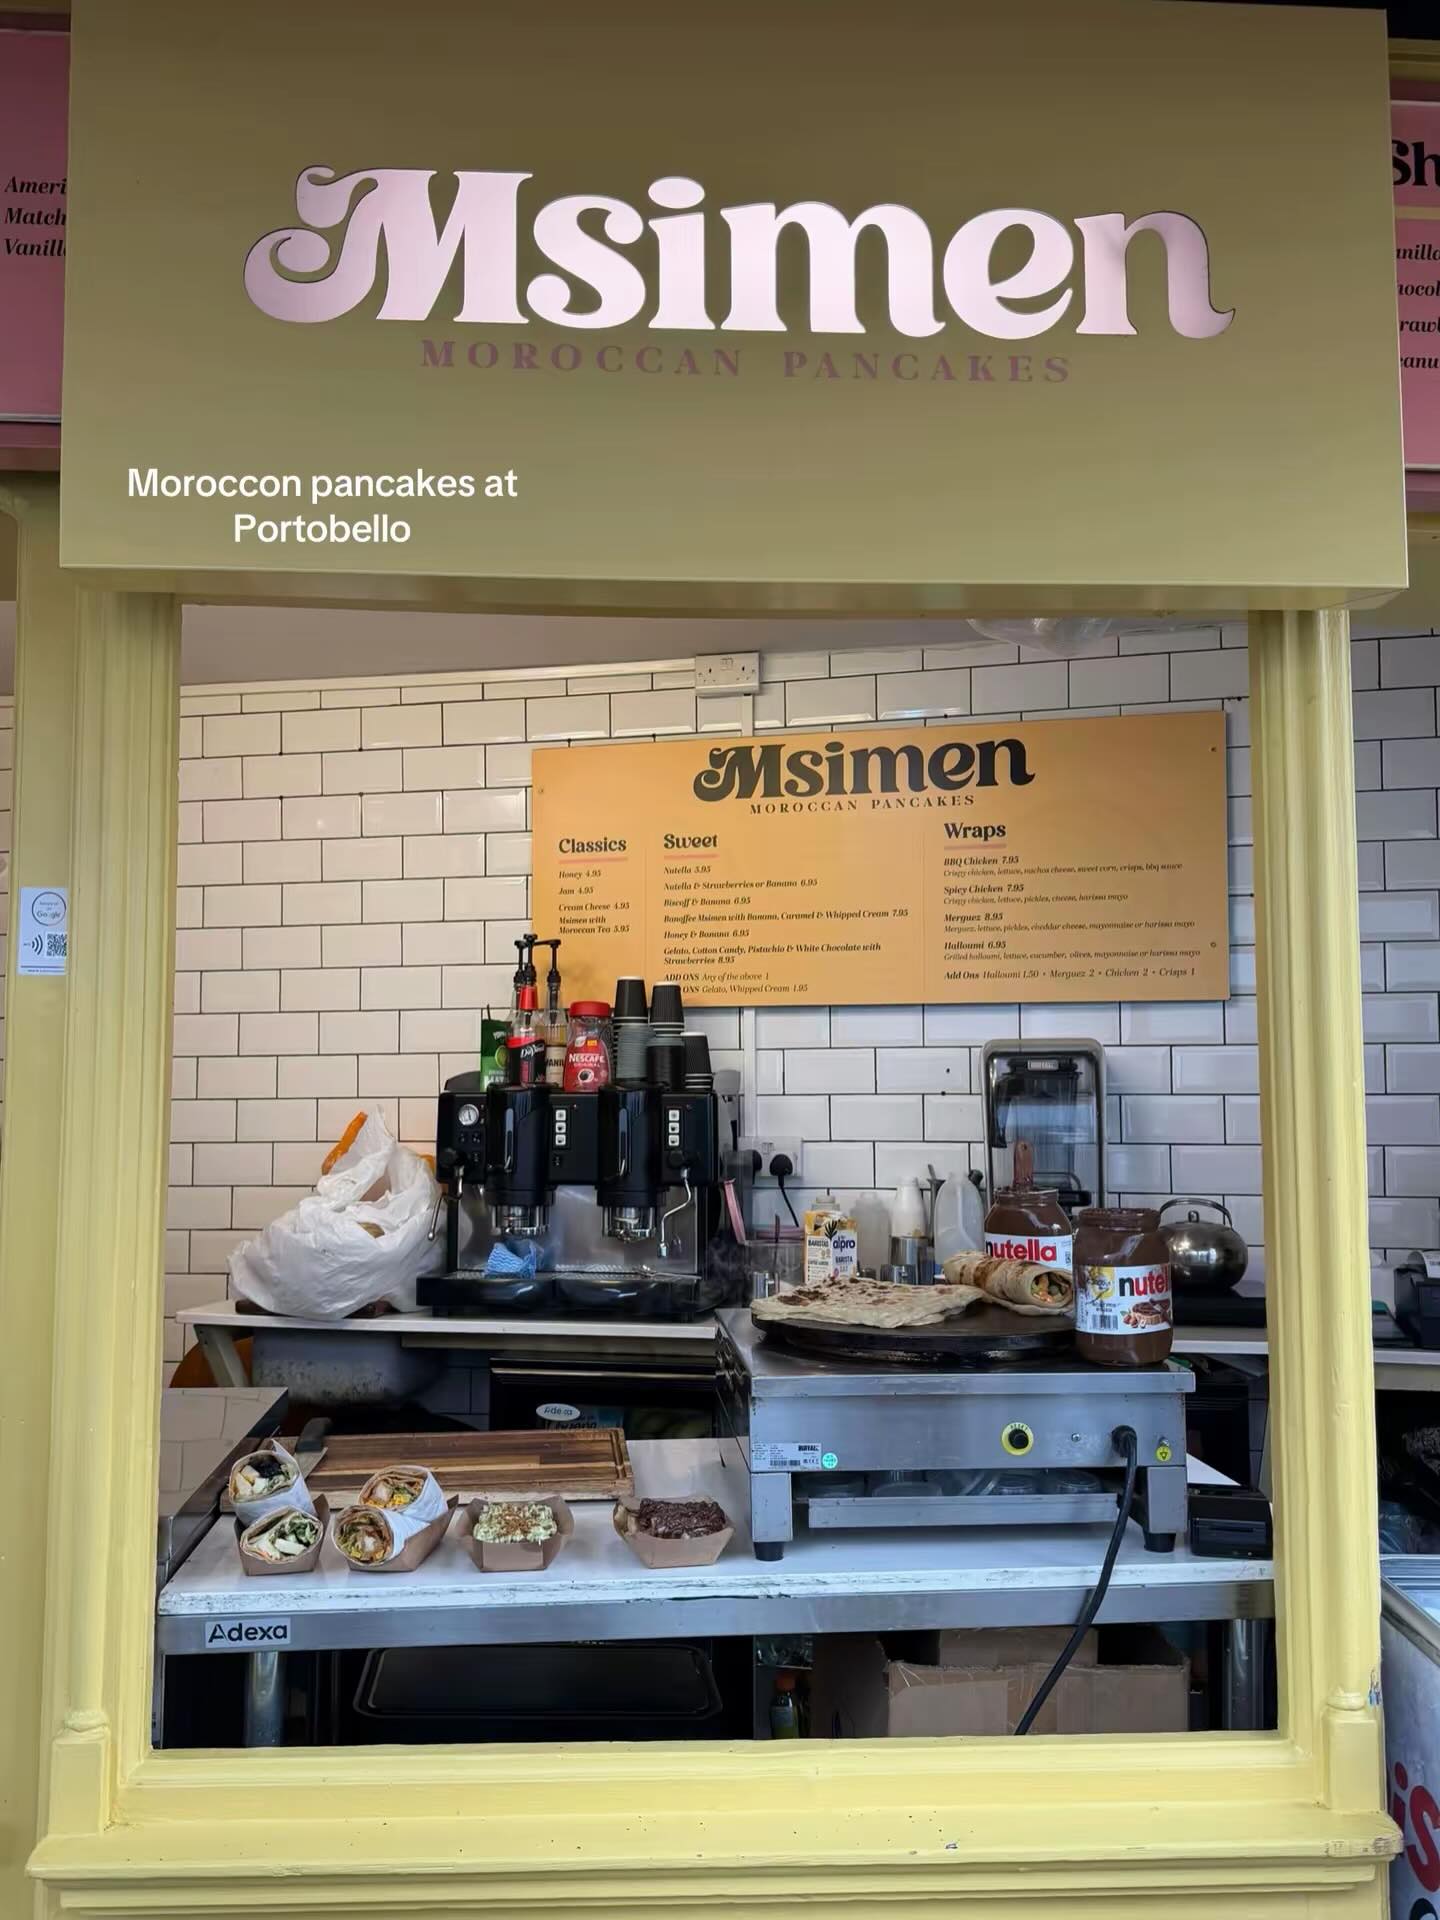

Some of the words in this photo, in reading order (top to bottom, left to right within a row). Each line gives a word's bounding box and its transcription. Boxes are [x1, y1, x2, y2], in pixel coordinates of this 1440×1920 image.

[4, 238, 66, 257] Vanill
[244, 165, 1235, 339] Msimen
[421, 339, 741, 378] MOROCCAN
[783, 350, 1071, 383] PANCAKES
[693, 738, 1036, 802] Msimen
[750, 799, 858, 815] MOROCCAN
[871, 795, 975, 809] PANCAKES
[943, 822, 1007, 842] Wraps
[558, 837, 627, 854] Classics
[663, 833, 718, 849] Sweet
[943, 858, 963, 868] BBQ
[963, 856, 999, 867] Chicken
[1001, 855, 1020, 865] 7.95
[558, 870, 583, 881] Honey
[663, 865, 692, 875] Nutella
[663, 881, 692, 891] Nutella
[702, 879, 755, 890] Strawberries
[755, 880, 766, 888] or
[766, 878, 798, 888] Banana
[800, 877, 818, 887] 6.95
[943, 886, 968, 896] Spicy
[968, 884, 1003, 894] Chicken
[1007, 883, 1025, 893] 7.95
[558, 887, 575, 896] Jam
[558, 903, 584, 912] Cream
[585, 902, 611, 911] Cheese
[663, 898, 690, 908] Biscoff
[700, 897, 731, 906] Banana
[733, 896, 751, 905] 6.95
[559, 916, 588, 925] Msimen
[588, 914, 607, 924] with
[663, 914, 697, 925] Banoffee
[698, 913, 727, 922] Msimen
[728, 912, 746, 921] with
[747, 912, 780, 922] Banana,
[781, 911, 815, 920] Caramel
[825, 910, 861, 921] Whipped
[862, 909, 889, 918] Cream
[892, 908, 909, 917] 7.95
[944, 914, 982, 924] Merguez
[984, 912, 1003, 921] 8.95
[559, 926, 596, 935] Moroccan
[597, 925, 611, 935] Tea
[663, 930, 688, 941] Honey
[699, 930, 730, 939] Banana
[732, 928, 750, 937] 6.95
[663, 946, 691, 956] Gelato,
[692, 945, 718, 955] Cotton
[719, 944, 746, 955] Candy,
[747, 943, 785, 954] Pistachio
[796, 943, 820, 953] White
[820, 942, 861, 952] Chocolate
[862, 942, 881, 952] with
[944, 941, 985, 950] Halloumi
[987, 940, 1006, 949] 6.95
[663, 957, 716, 965] Strawberries
[717, 956, 736, 965] 8.95
[682, 973, 700, 982] ONS
[702, 973, 717, 983] Any
[717, 972, 726, 983] of
[726, 972, 739, 981] the
[739, 971, 763, 981] above
[944, 970, 961, 980] Add
[962, 970, 979, 980] Ons
[982, 969, 1021, 979] Halloumi
[1049, 969, 1087, 980] Merguez
[1089, 968, 1096, 977] 2
[1105, 967, 1140, 978] Chicken
[1142, 967, 1149, 977] 2
[1158, 967, 1188, 979] Crisps
[729, 984, 764, 995] Whipped
[764, 983, 790, 994] Cream
[985, 1239, 1057, 1262] nutella
[208, 1622, 288, 1643] Adexa
